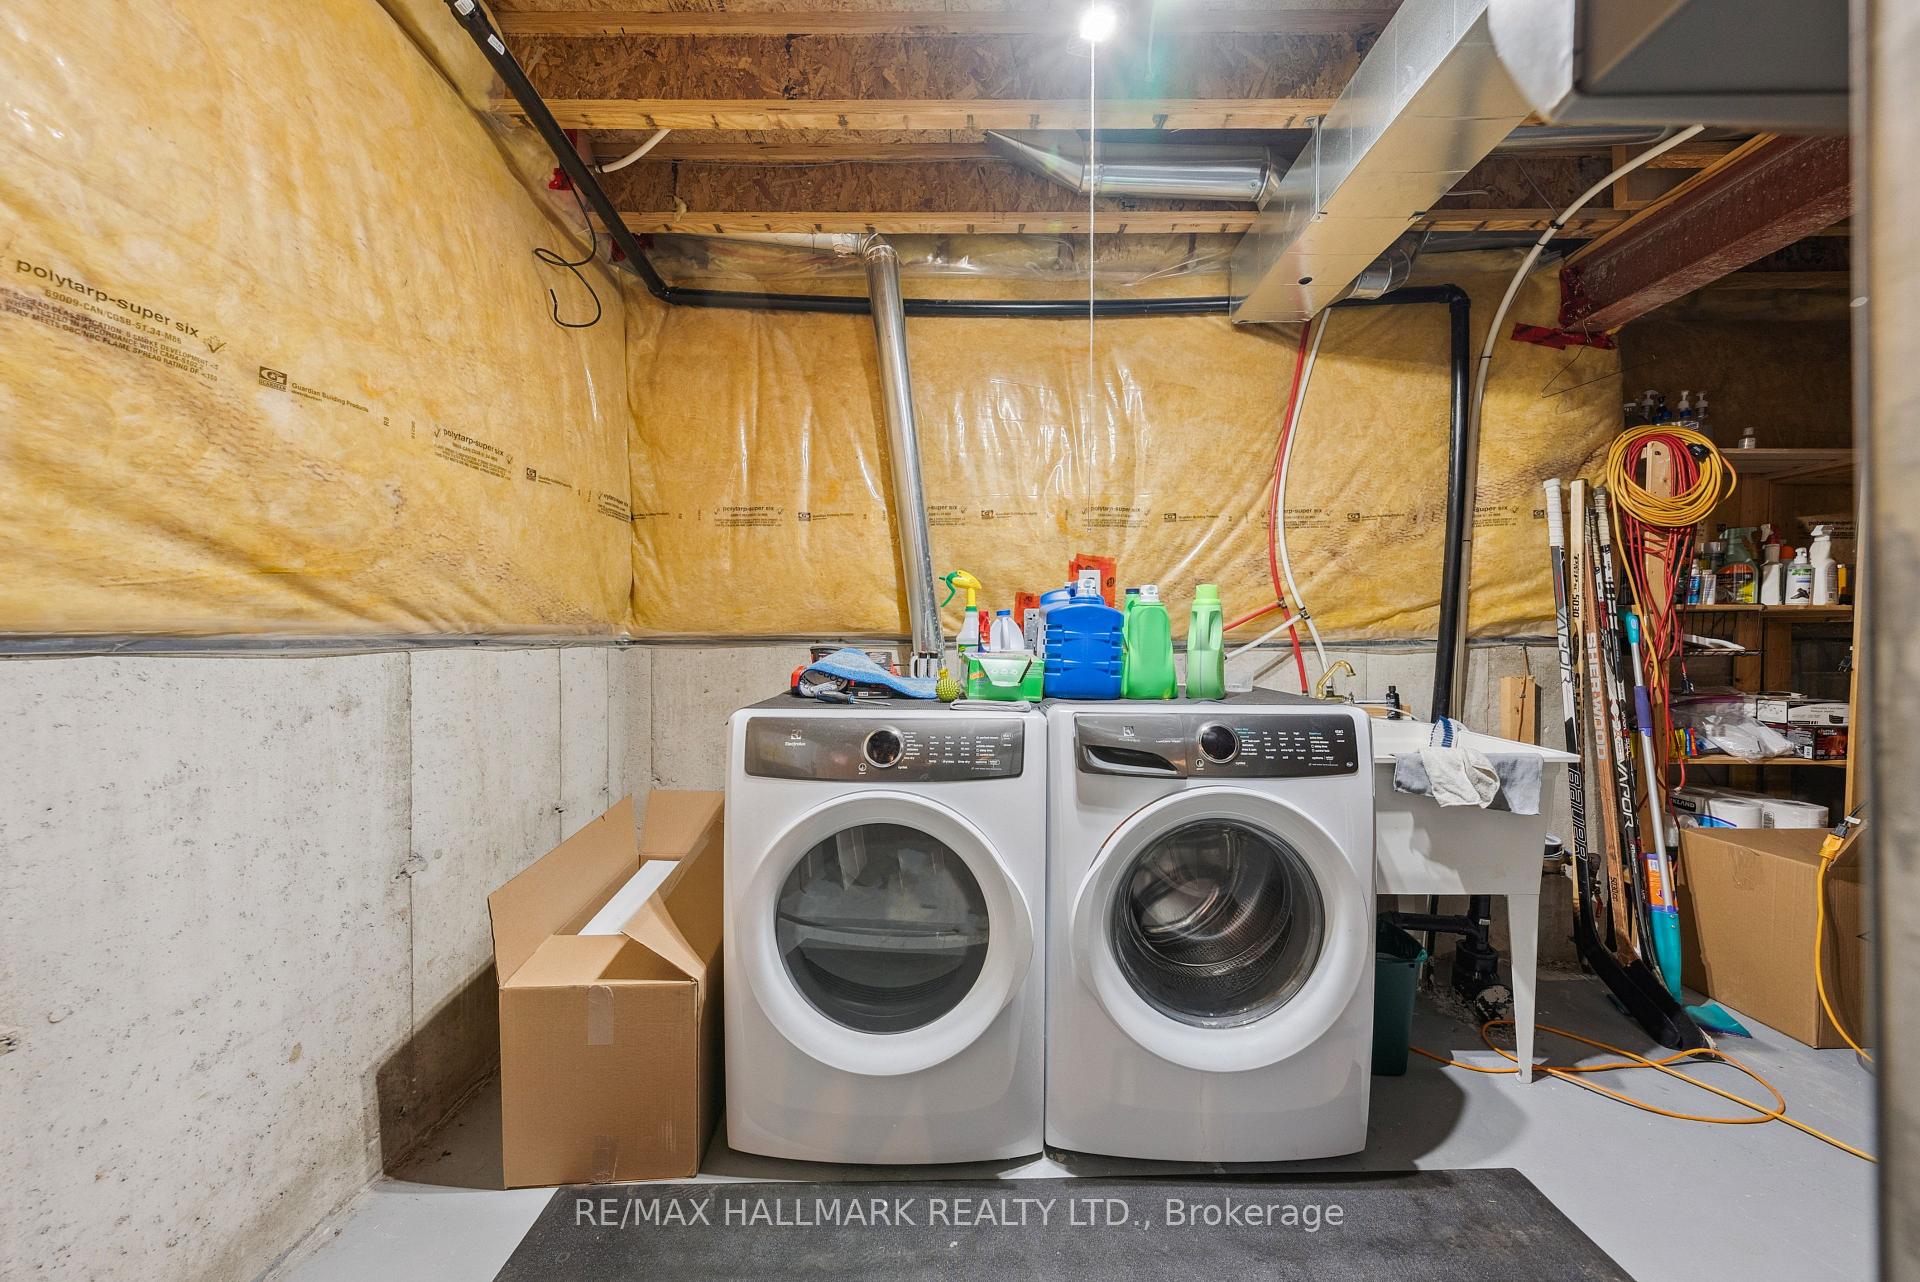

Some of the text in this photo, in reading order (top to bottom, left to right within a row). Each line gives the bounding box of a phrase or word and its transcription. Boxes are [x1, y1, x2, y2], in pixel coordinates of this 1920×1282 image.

[16, 259, 200, 338] polytarp-super six
[1572, 594, 1580, 618] 5030
[1556, 606, 1573, 684] VAPOR
[1616, 758, 1634, 829] VAPOR
